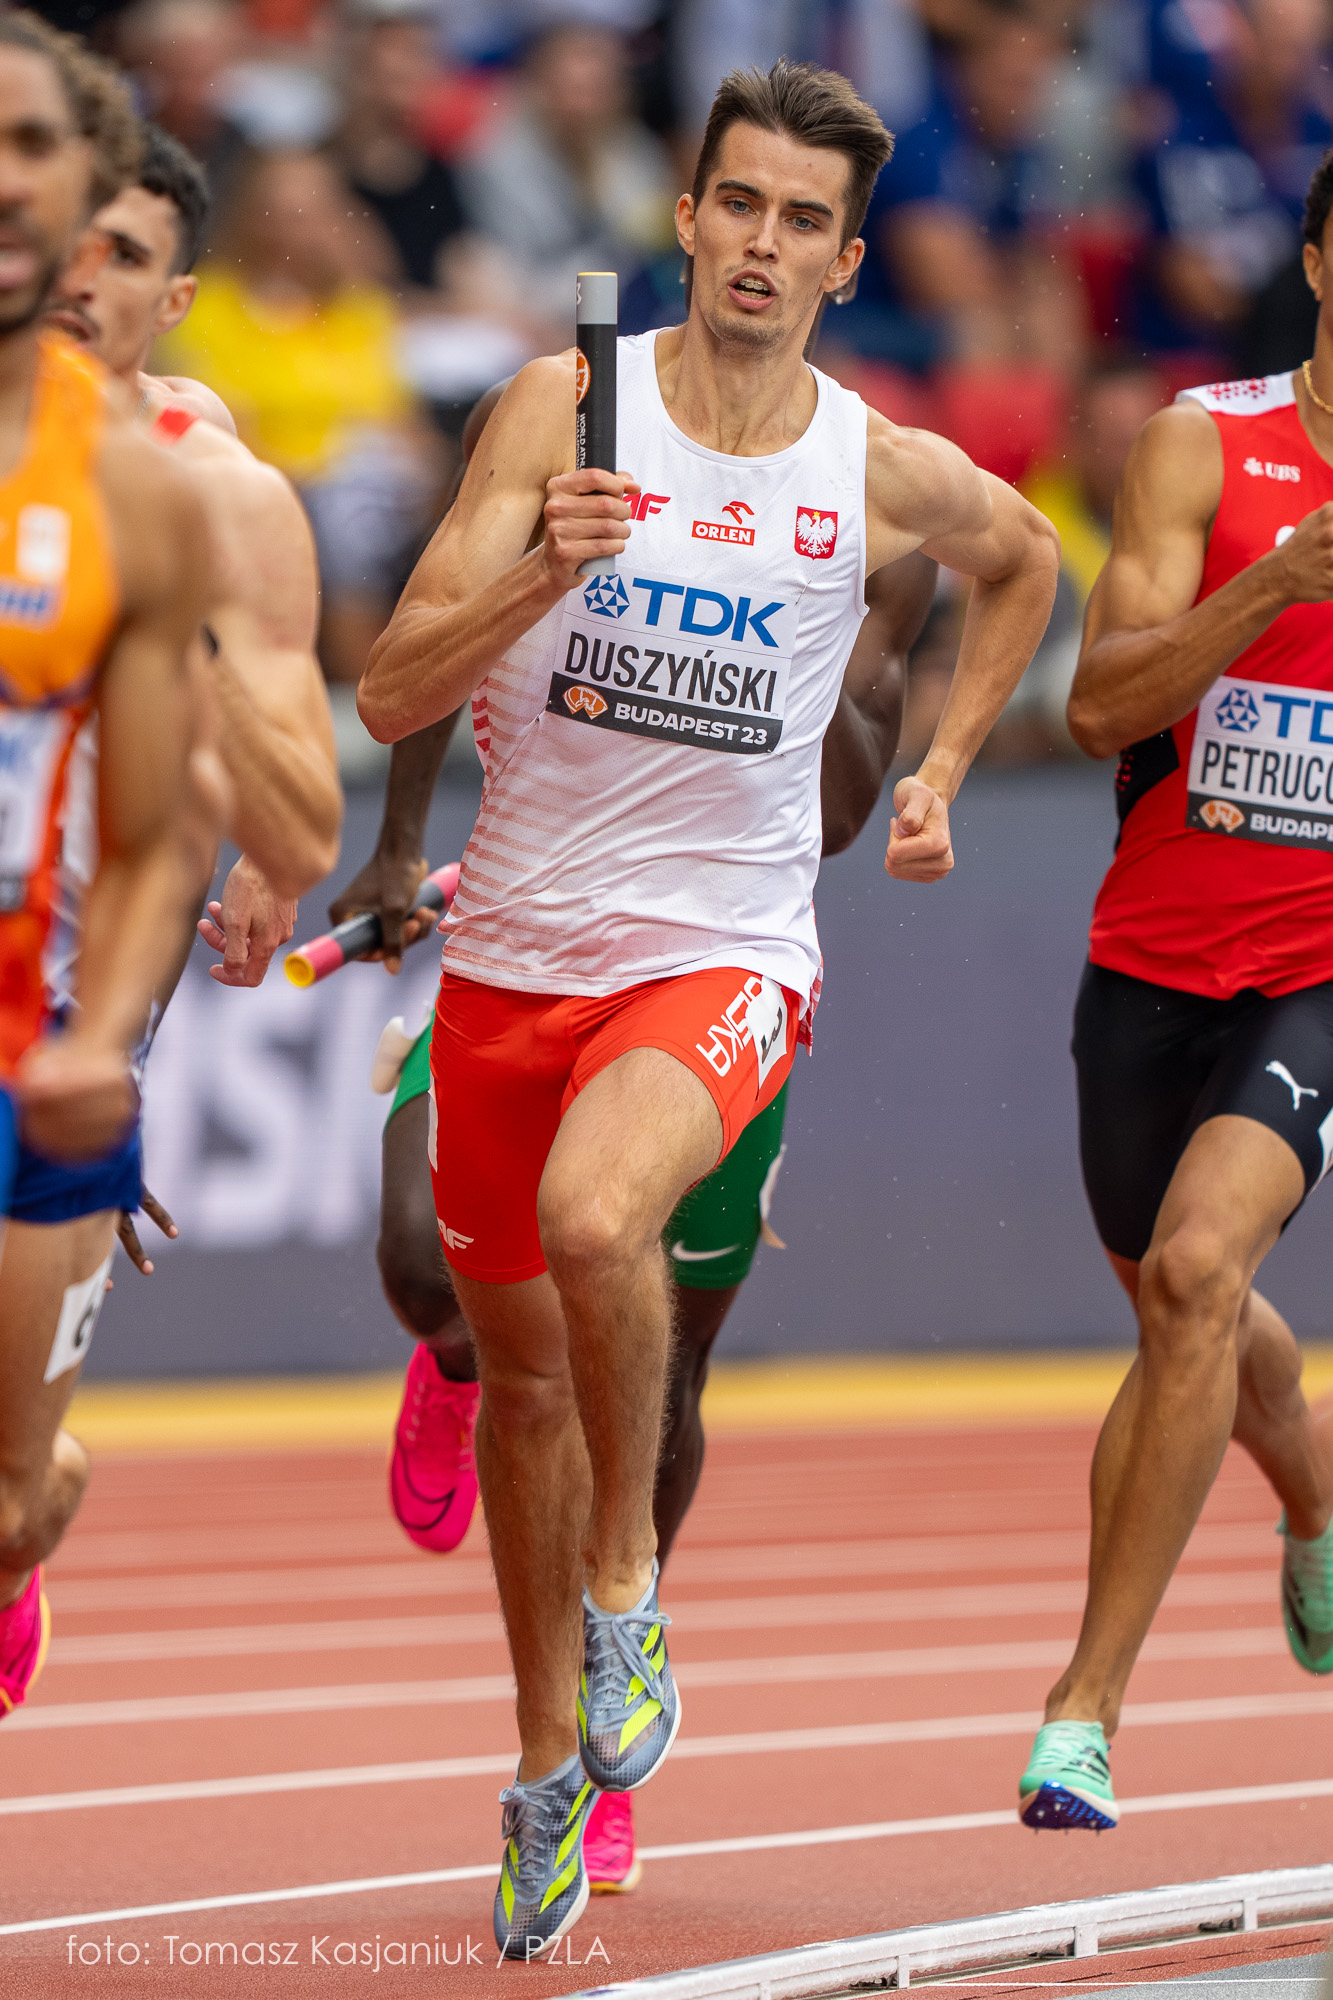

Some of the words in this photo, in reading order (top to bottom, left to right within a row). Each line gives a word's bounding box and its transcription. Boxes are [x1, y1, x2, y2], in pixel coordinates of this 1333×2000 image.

[1265, 461, 1301, 483] UBS
[694, 523, 752, 544] ORLEN
[632, 577, 786, 648] TDK
[564, 630, 778, 713] DUSZYŃSKI
[614, 702, 739, 742] BUDAPEST
[740, 726, 768, 746] 23
